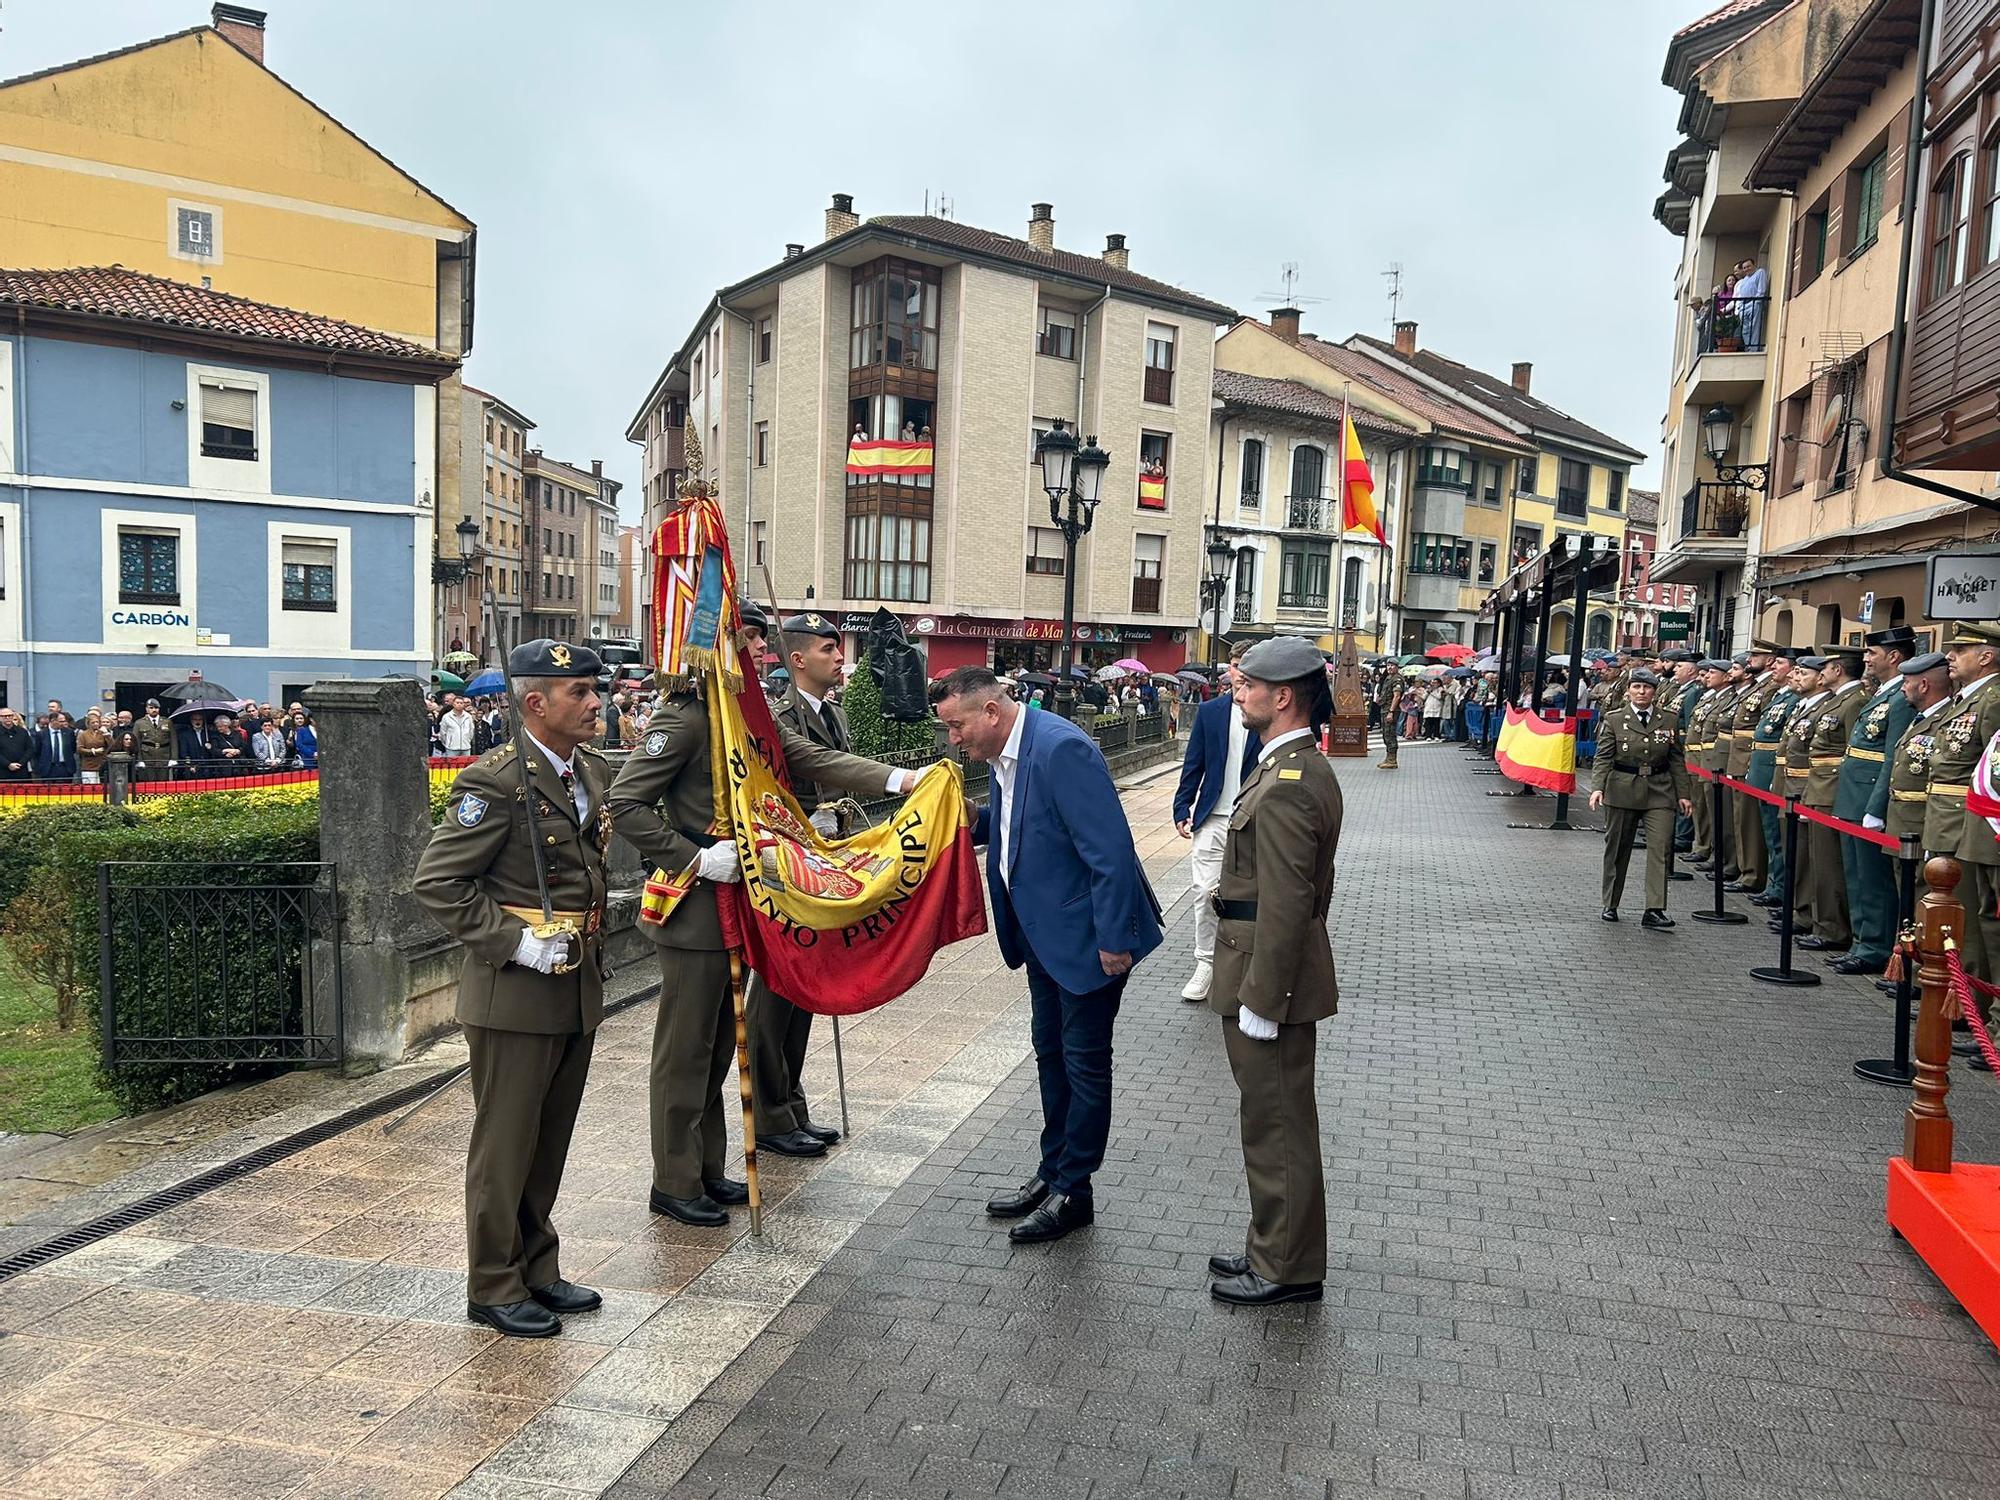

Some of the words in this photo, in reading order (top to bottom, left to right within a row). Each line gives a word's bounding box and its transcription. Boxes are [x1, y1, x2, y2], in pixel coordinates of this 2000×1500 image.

[1937, 580, 1997, 597] HATCHET
[112, 610, 189, 626] CARBÓN
[937, 620, 954, 635] La
[957, 621, 1023, 638] Carnicería
[1026, 623, 1038, 638] de
[841, 810, 927, 948] PRINCIPE
